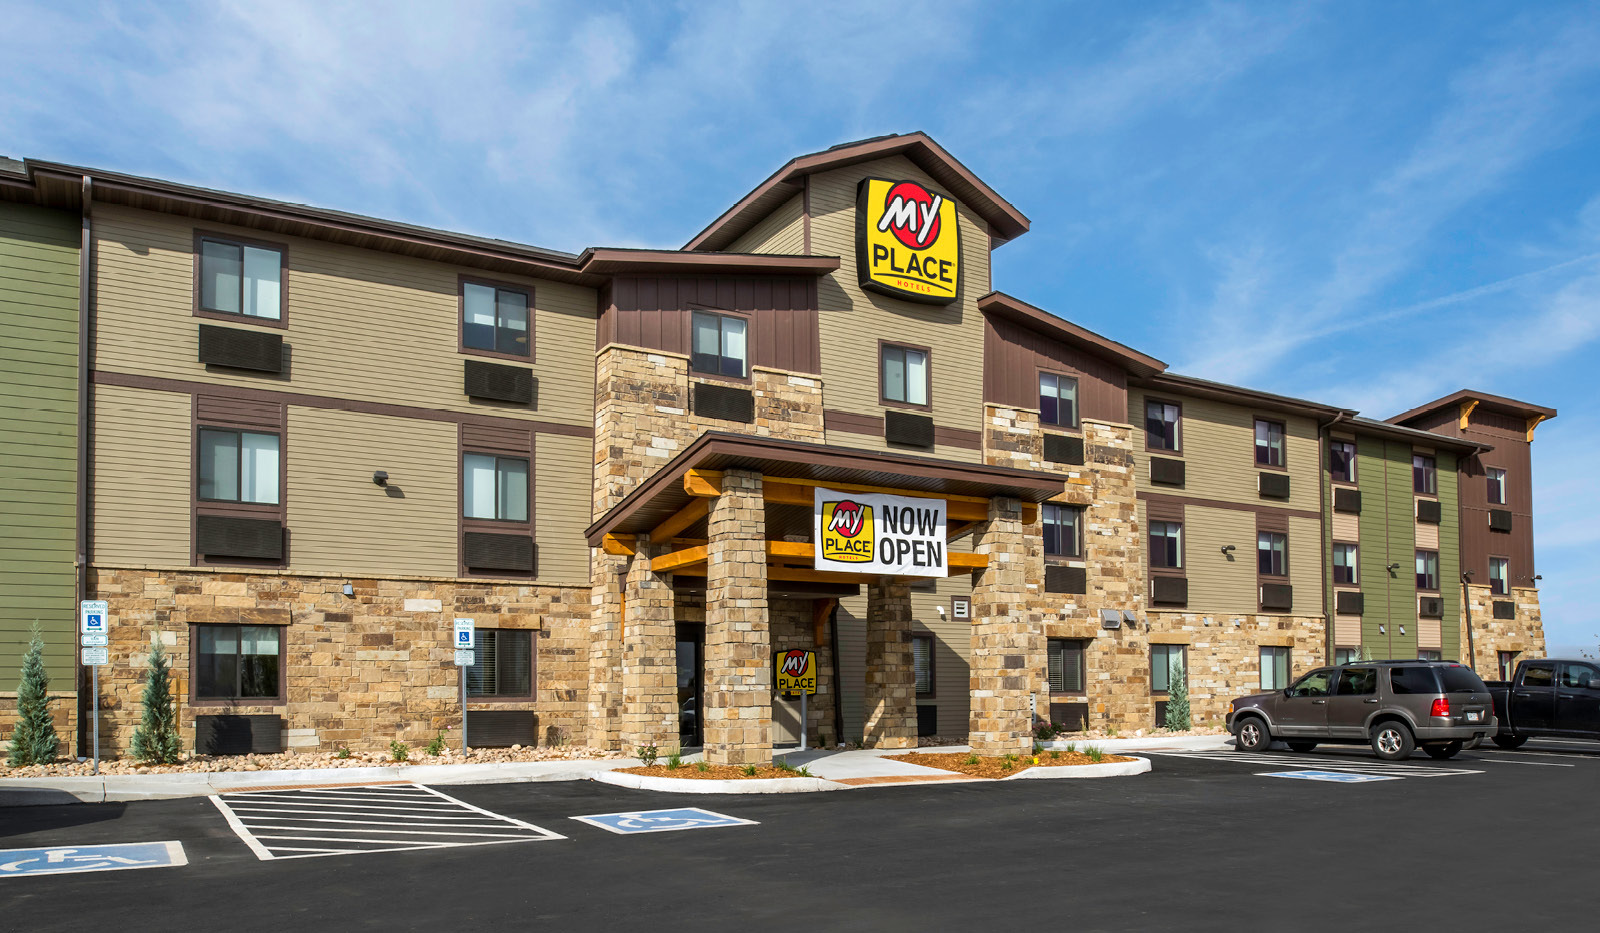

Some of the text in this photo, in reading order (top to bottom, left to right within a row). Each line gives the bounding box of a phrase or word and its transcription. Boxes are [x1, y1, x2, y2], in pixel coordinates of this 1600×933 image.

[873, 243, 953, 284] PLACE
[897, 279, 931, 293] HOTELS
[882, 505, 939, 537] NOW
[826, 538, 871, 553] PLACE
[879, 537, 942, 568] OPEN
[779, 678, 815, 689] PLACE
